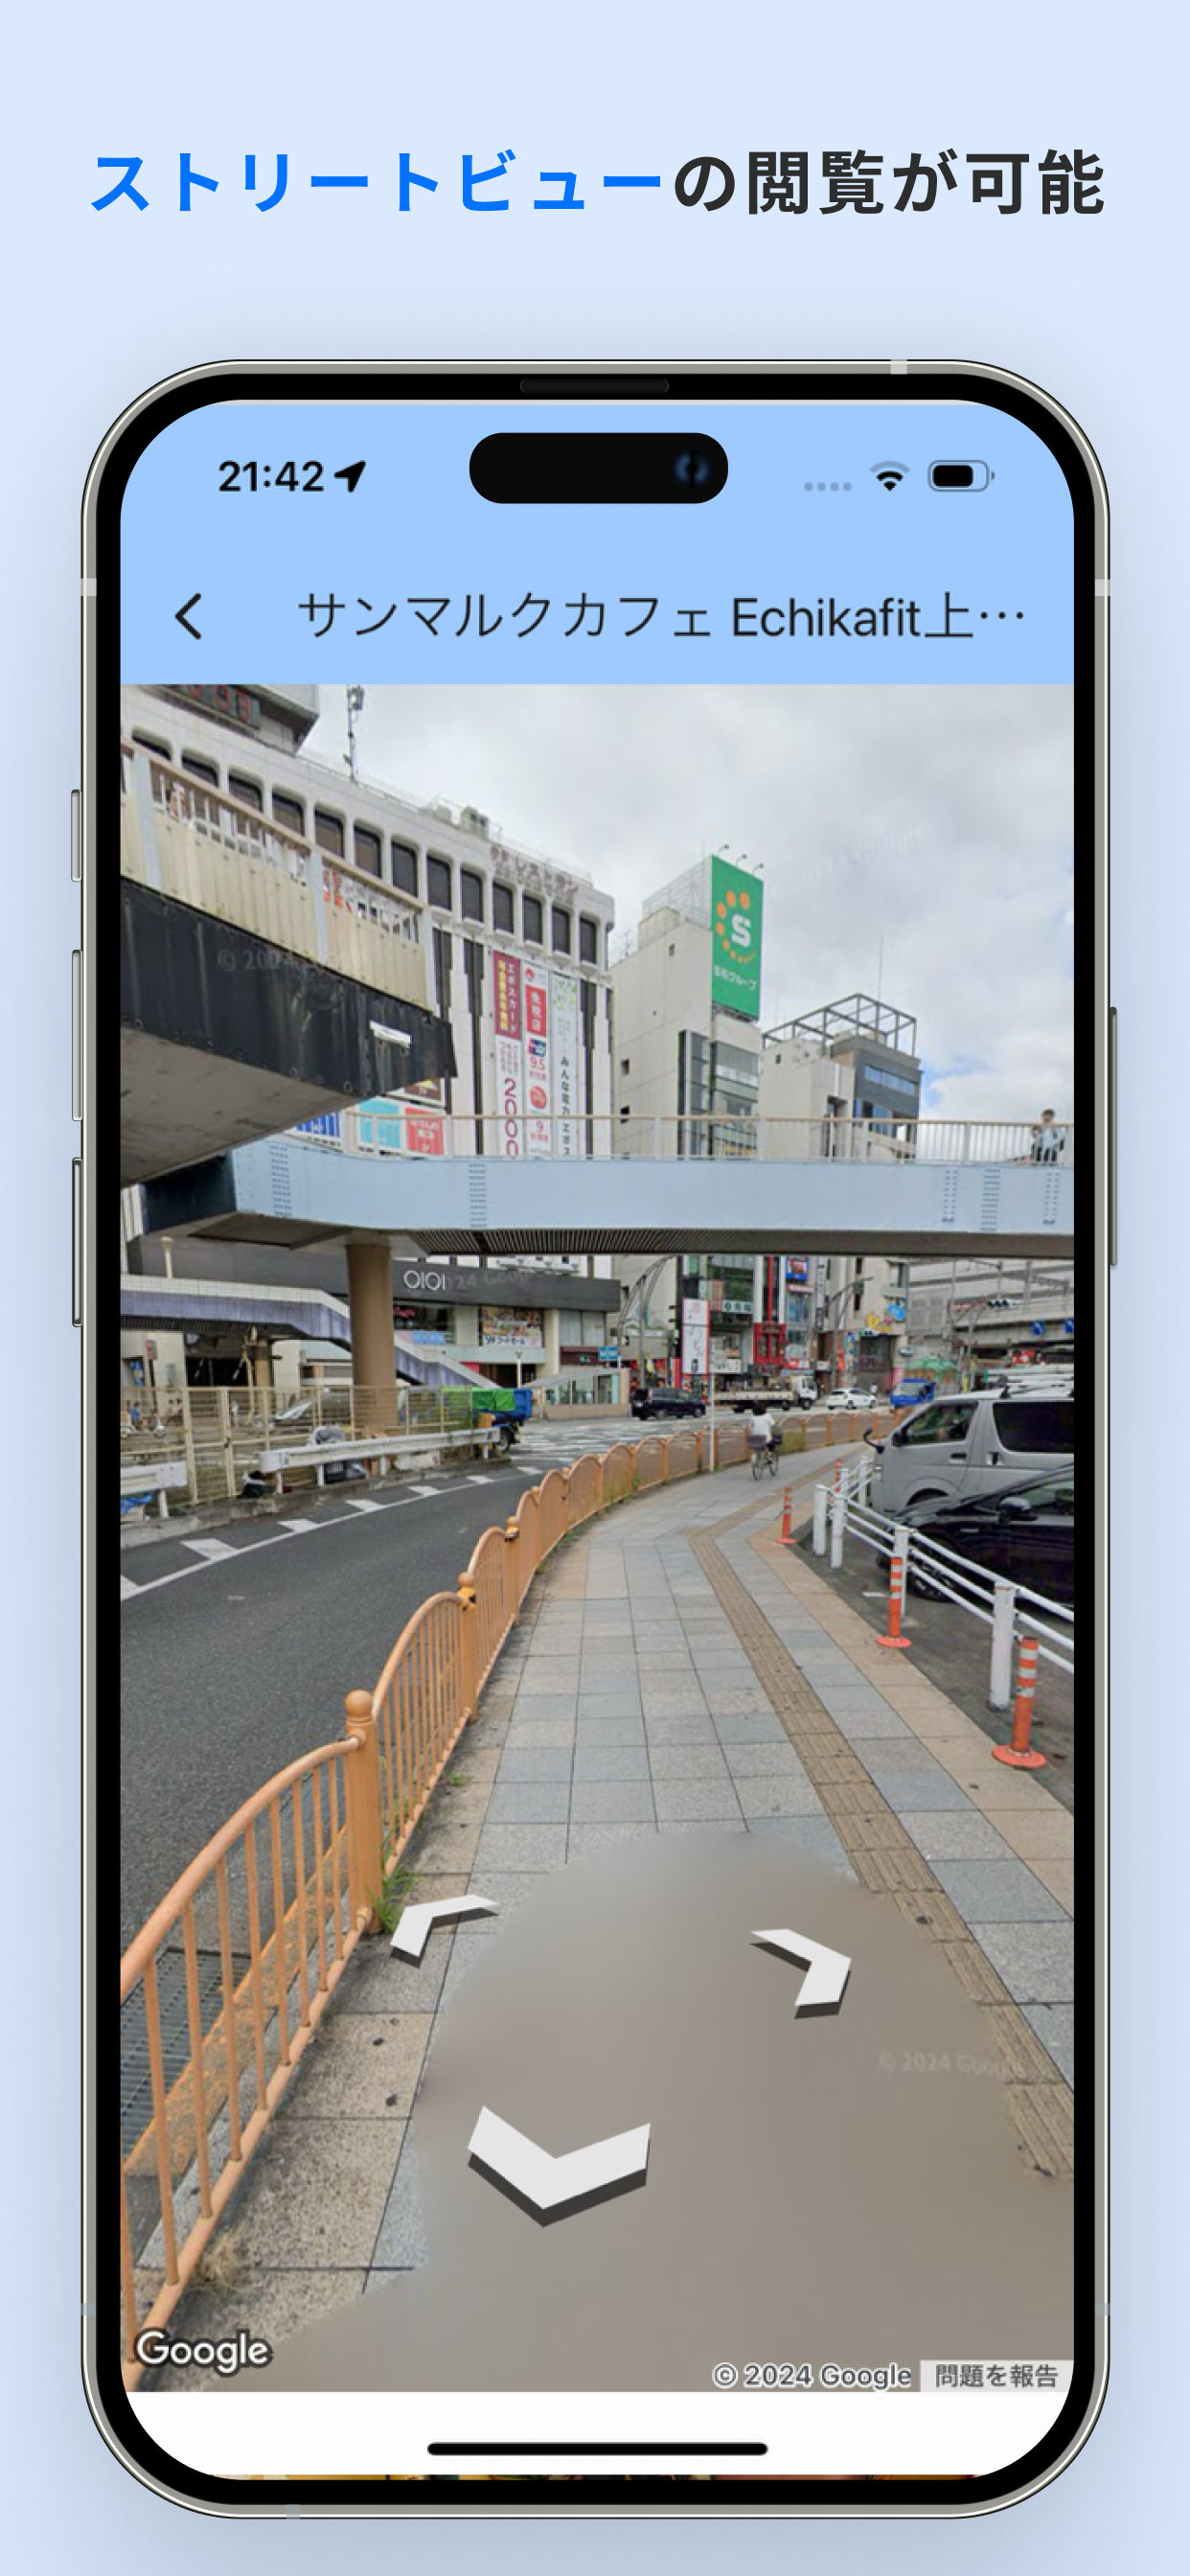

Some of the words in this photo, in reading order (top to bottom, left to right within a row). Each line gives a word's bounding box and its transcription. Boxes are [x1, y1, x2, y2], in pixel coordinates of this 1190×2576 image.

[219, 461, 324, 492] 21:42
[299, 593, 710, 637] サンマルクカフェ
[136, 2331, 268, 2374] Google
[744, 2364, 812, 2387] 2024
[821, 2363, 911, 2391] Google
[935, 2364, 1058, 2388] 問題を報告
